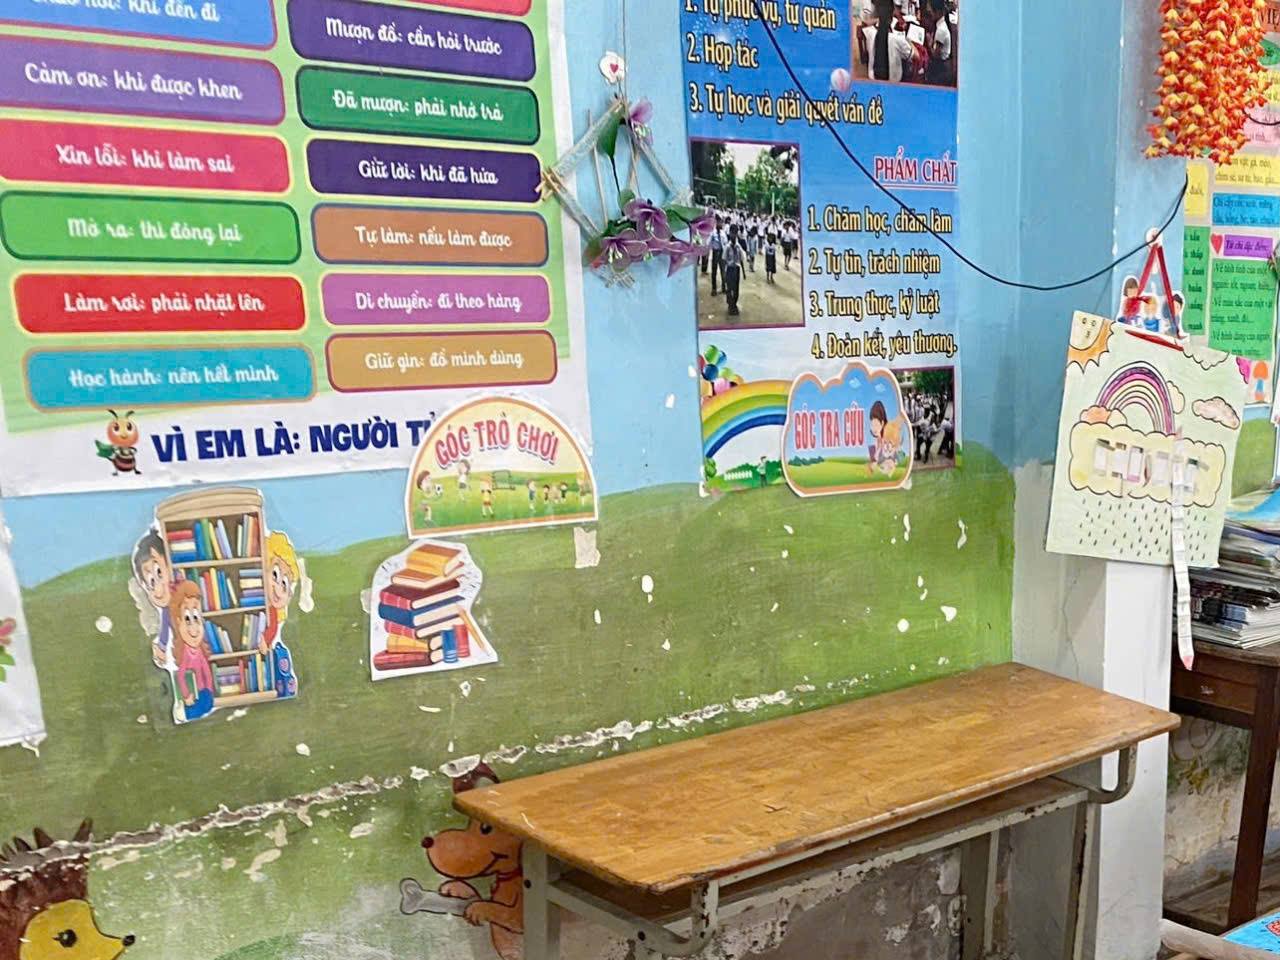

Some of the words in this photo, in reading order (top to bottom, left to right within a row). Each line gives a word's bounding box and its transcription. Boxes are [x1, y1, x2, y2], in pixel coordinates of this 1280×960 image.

[687, 33, 700, 63] 2.
[704, 35, 732, 71] Hợp
[737, 39, 759, 68] tác
[114, 70, 147, 92] khi
[199, 79, 242, 100] khen
[690, 82, 703, 112] 3.
[705, 85, 724, 121] Tự
[727, 85, 753, 122] học
[757, 90, 772, 116] và
[56, 144, 91, 165] Xin
[132, 149, 163, 169] khi
[208, 156, 234, 173] sai
[420, 163, 445, 182] khi
[808, 204, 821, 232] 1.
[865, 206, 891, 238] học,
[808, 247, 822, 274] 2.
[824, 247, 842, 280] Tự
[844, 249, 865, 276] tin,
[868, 248, 900, 274] trách
[903, 248, 941, 279] nhiệm
[239, 293, 265, 311] lên
[810, 291, 823, 317] 3.
[825, 291, 863, 322] Trung
[865, 290, 896, 320] thực,
[915, 288, 940, 318] luật
[811, 333, 824, 359] 4.
[827, 333, 861, 358] Đoàn
[888, 330, 911, 360] yêu
[151, 415, 188, 463] VÌ
[198, 429, 246, 460] EM
[255, 421, 300, 458] LÀ:
[310, 416, 398, 454] NGƯỜI
[435, 425, 471, 467] GÓC
[819, 410, 841, 448] TRA
